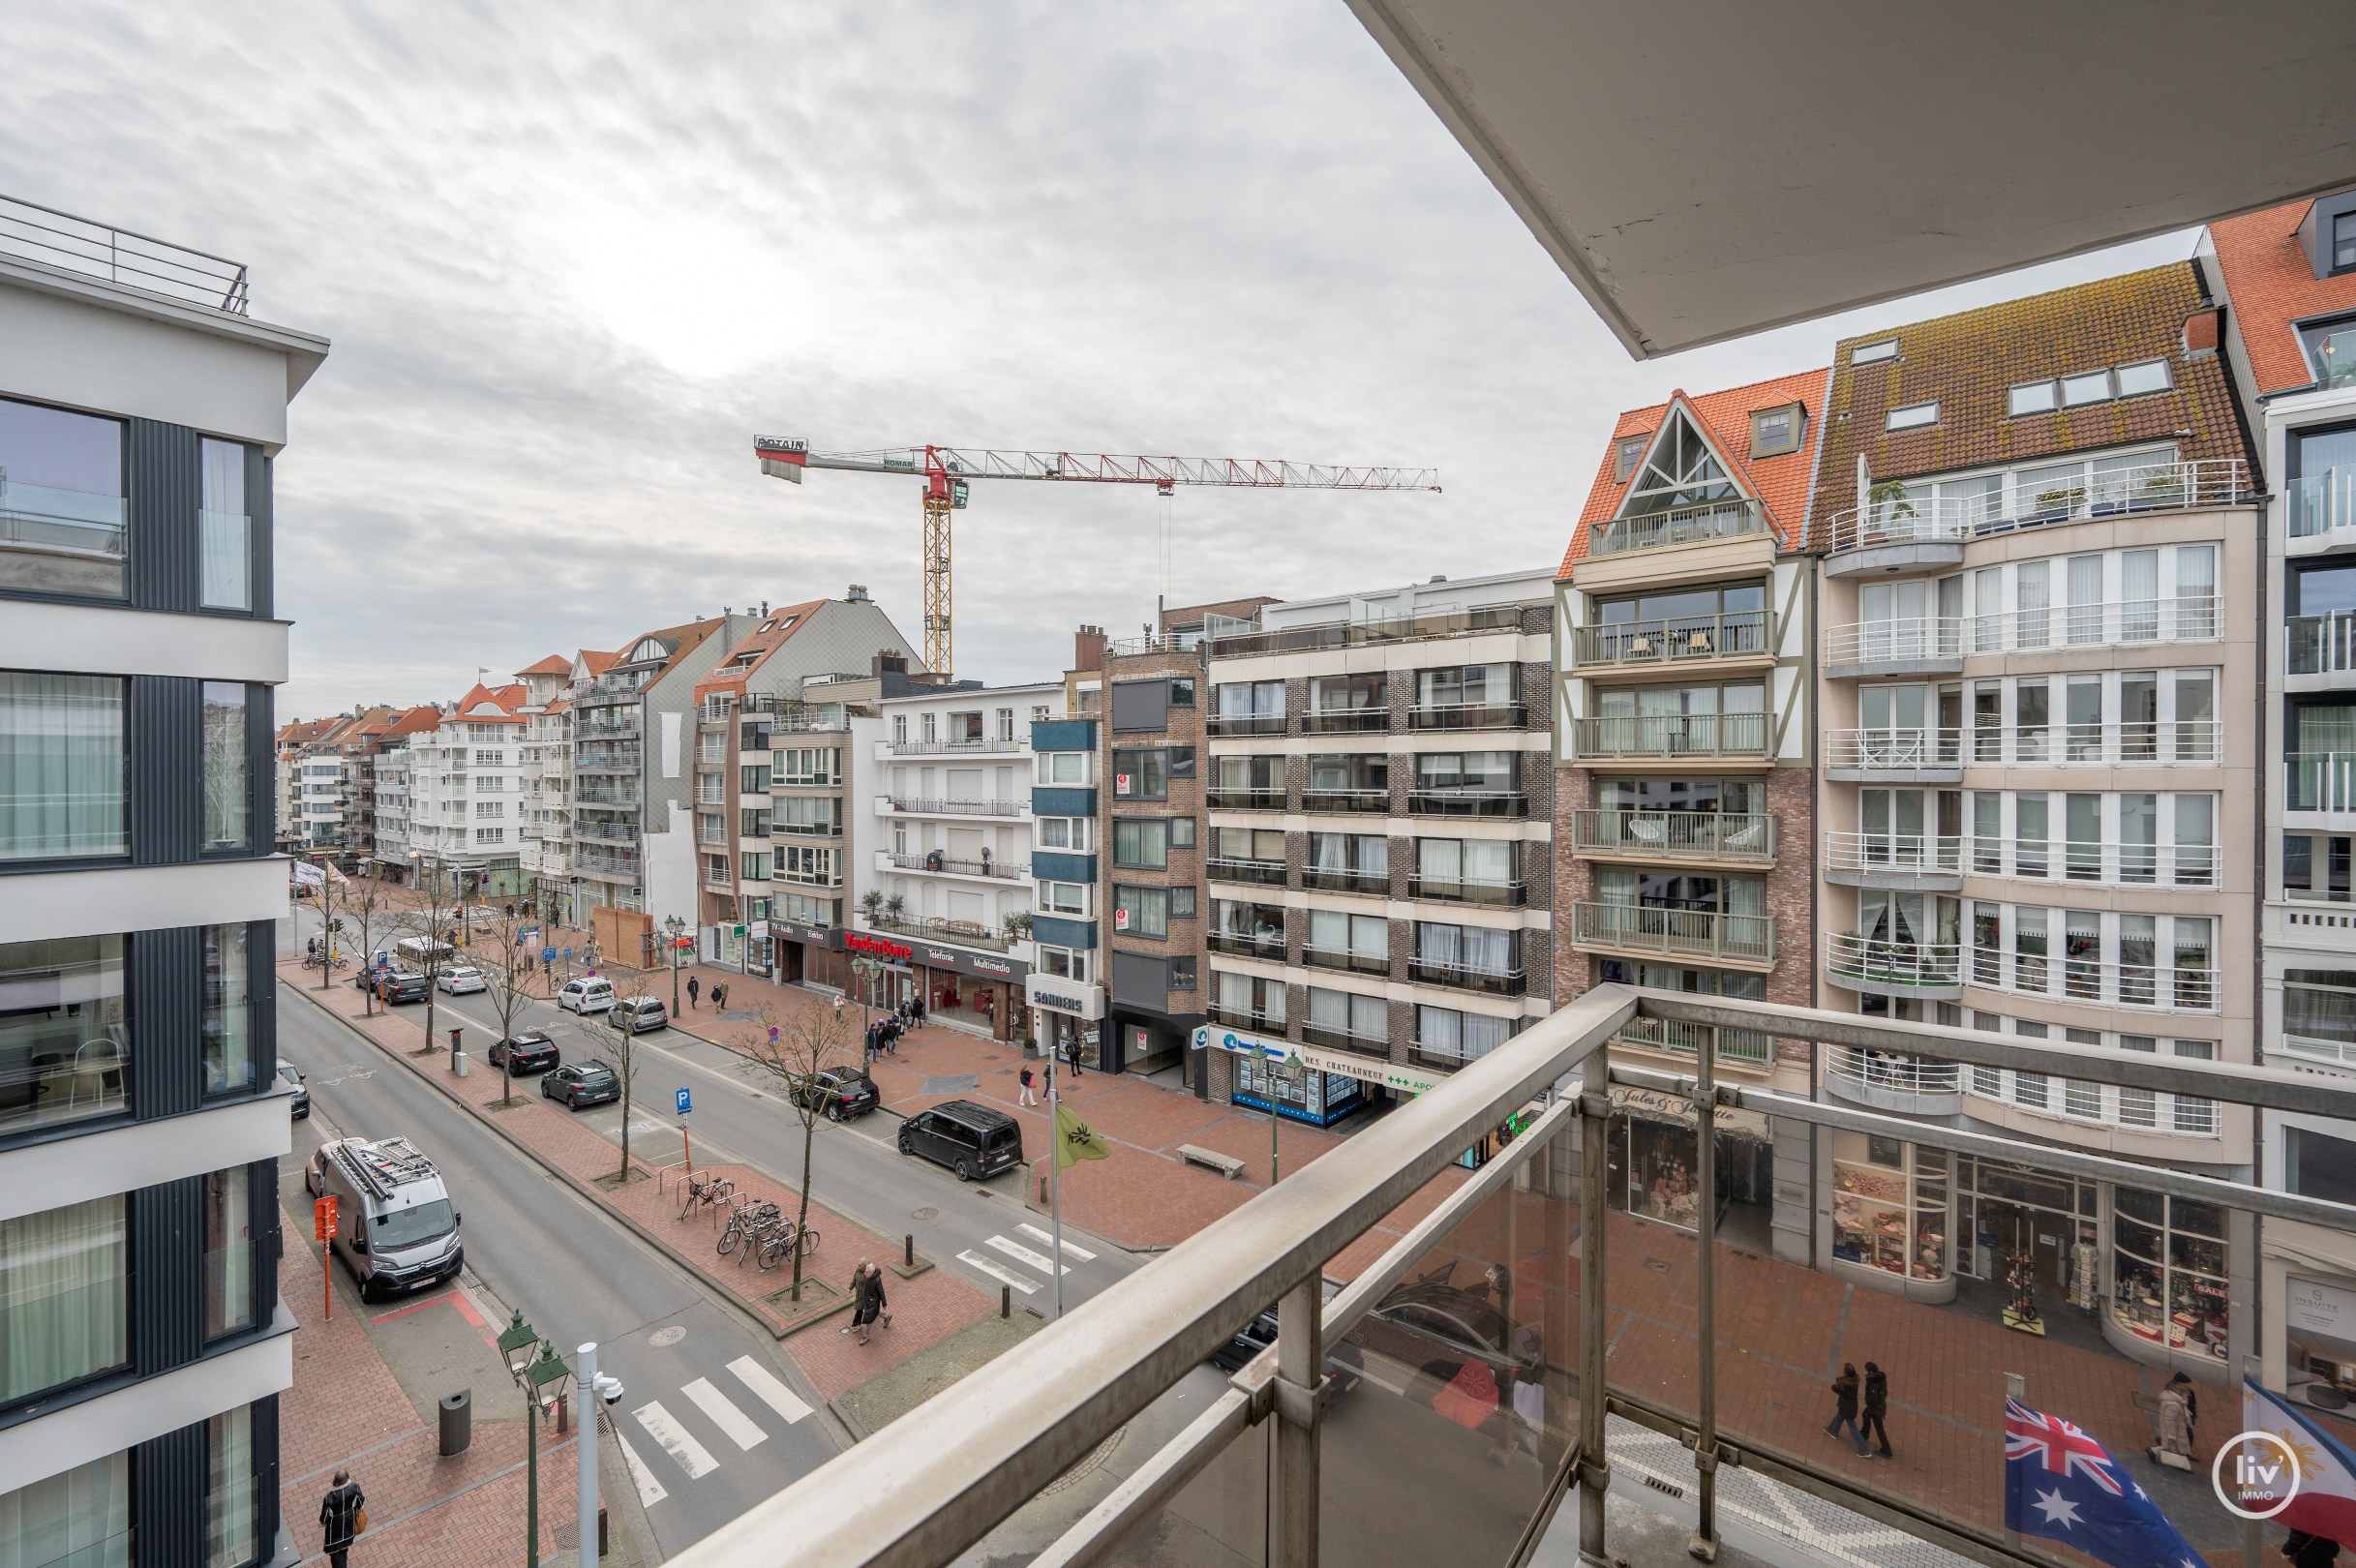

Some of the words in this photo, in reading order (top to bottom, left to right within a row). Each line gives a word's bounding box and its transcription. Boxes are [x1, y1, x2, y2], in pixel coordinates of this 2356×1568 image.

[757, 437, 804, 451] POTAIN
[884, 459, 914, 468] ROMAR
[771, 922, 778, 931] TV
[780, 924, 794, 935] Audio
[845, 931, 882, 954] Vanden
[882, 938, 913, 959] Borre
[378, 952, 387, 962] P
[928, 949, 954, 963] Telefonie
[973, 957, 1011, 974] Multimedia
[1034, 990, 1083, 1012] SANDERS
[1326, 1061, 1384, 1080] CHATEAUNEUF
[678, 1091, 688, 1106] P
[1614, 1088, 1656, 1105] Jules
[1655, 1095, 1672, 1111] &
[2197, 1284, 2225, 1298] SALE
[2295, 1296, 2340, 1312] INSUITE
